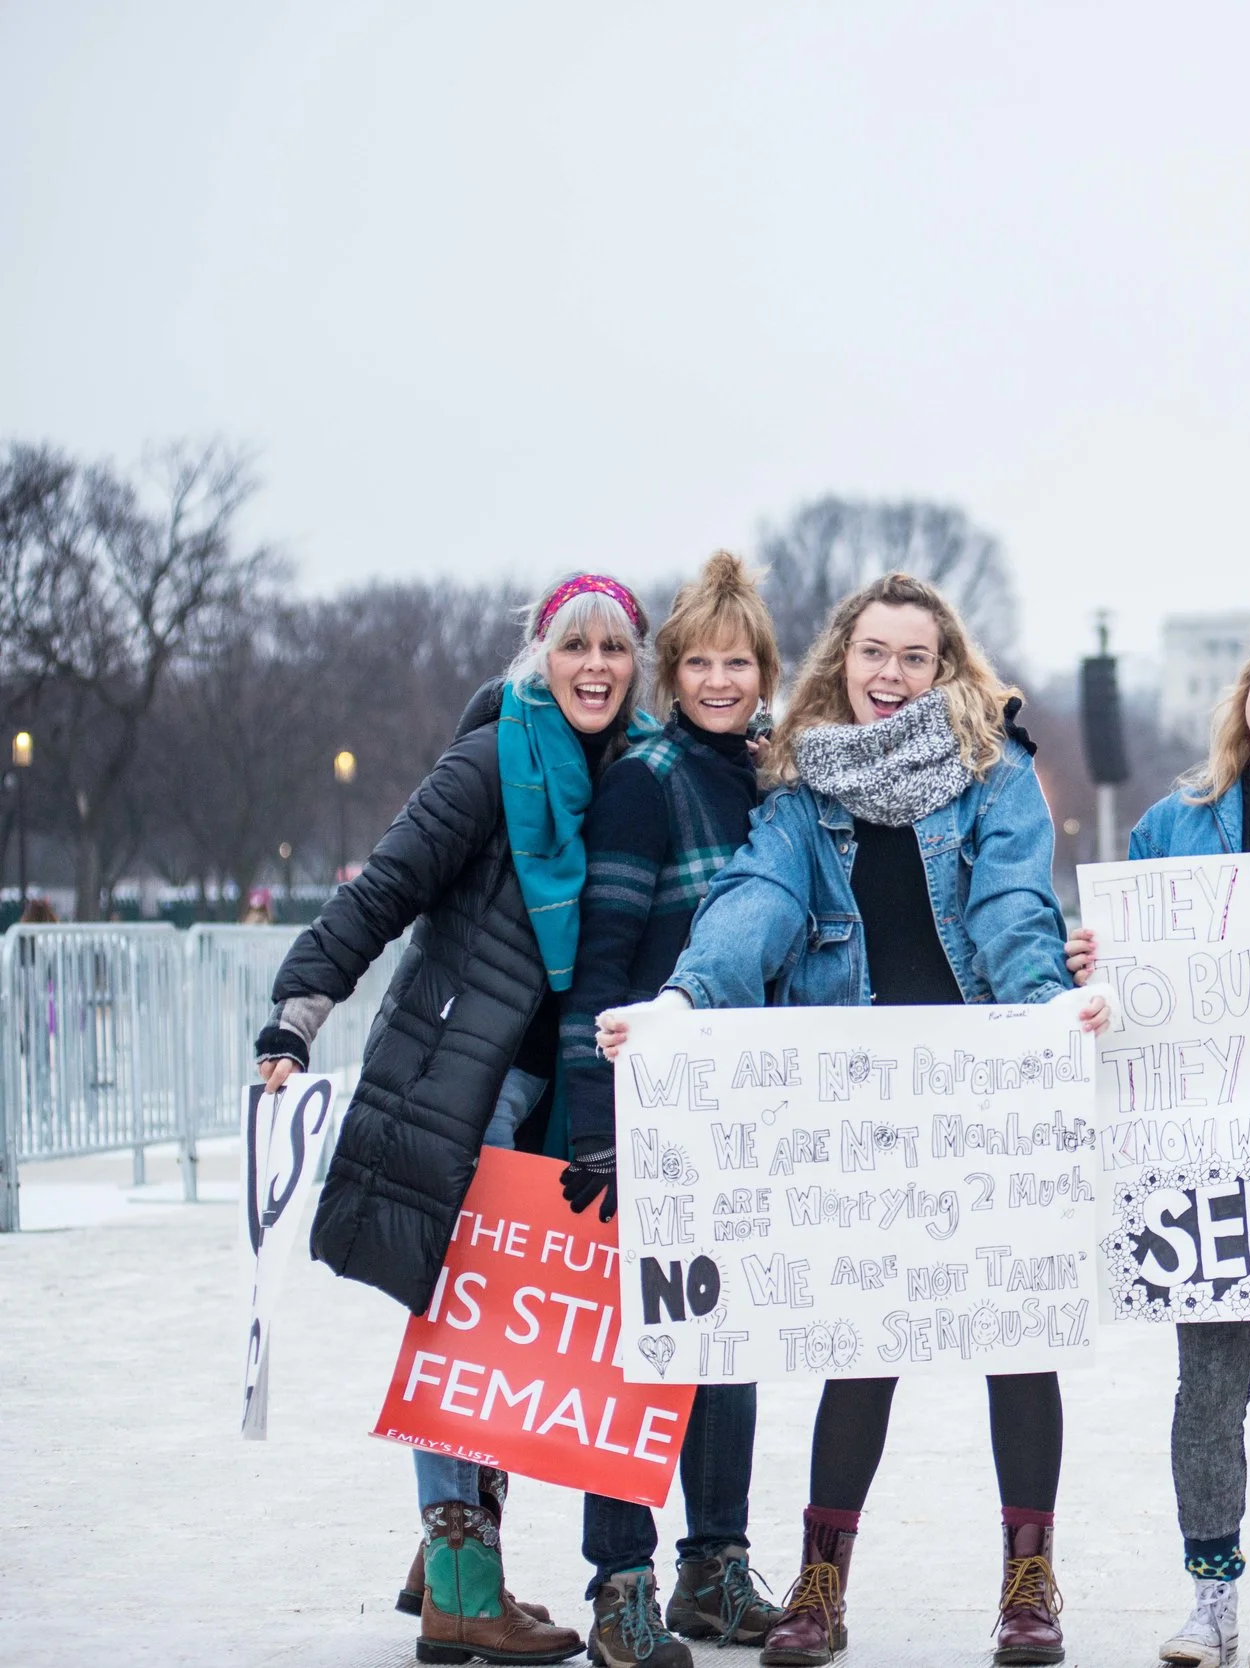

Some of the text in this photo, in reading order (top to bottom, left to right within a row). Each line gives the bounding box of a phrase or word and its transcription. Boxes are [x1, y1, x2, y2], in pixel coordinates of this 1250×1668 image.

[1093, 864, 1238, 942] THEY
[1095, 957, 1178, 1032] TO
[630, 1052, 719, 1110] WE
[731, 1048, 802, 1089] ARE
[913, 1031, 1090, 1095] Paranoid.
[1101, 1034, 1245, 1113] THEY
[711, 1122, 758, 1170] WE
[769, 1128, 830, 1175] ARE
[1101, 1118, 1215, 1171] KNOW
[636, 1194, 694, 1246] WE
[713, 1188, 772, 1214] ARE
[786, 1183, 958, 1240] Worrying
[964, 1173, 995, 1210] 2
[451, 1210, 530, 1257] THE
[714, 1219, 771, 1242] NOT
[428, 1266, 487, 1330] IS
[741, 1253, 814, 1308] WE
[831, 1255, 897, 1290] ARE
[908, 1262, 968, 1301] NOT
[976, 1246, 1087, 1291] TAKIN'
[699, 1298, 1090, 1375] IT TOO SERIOUSLY.
[403, 1350, 678, 1465] FEMALE
[386, 1428, 495, 1463] EMILY'S LIST
